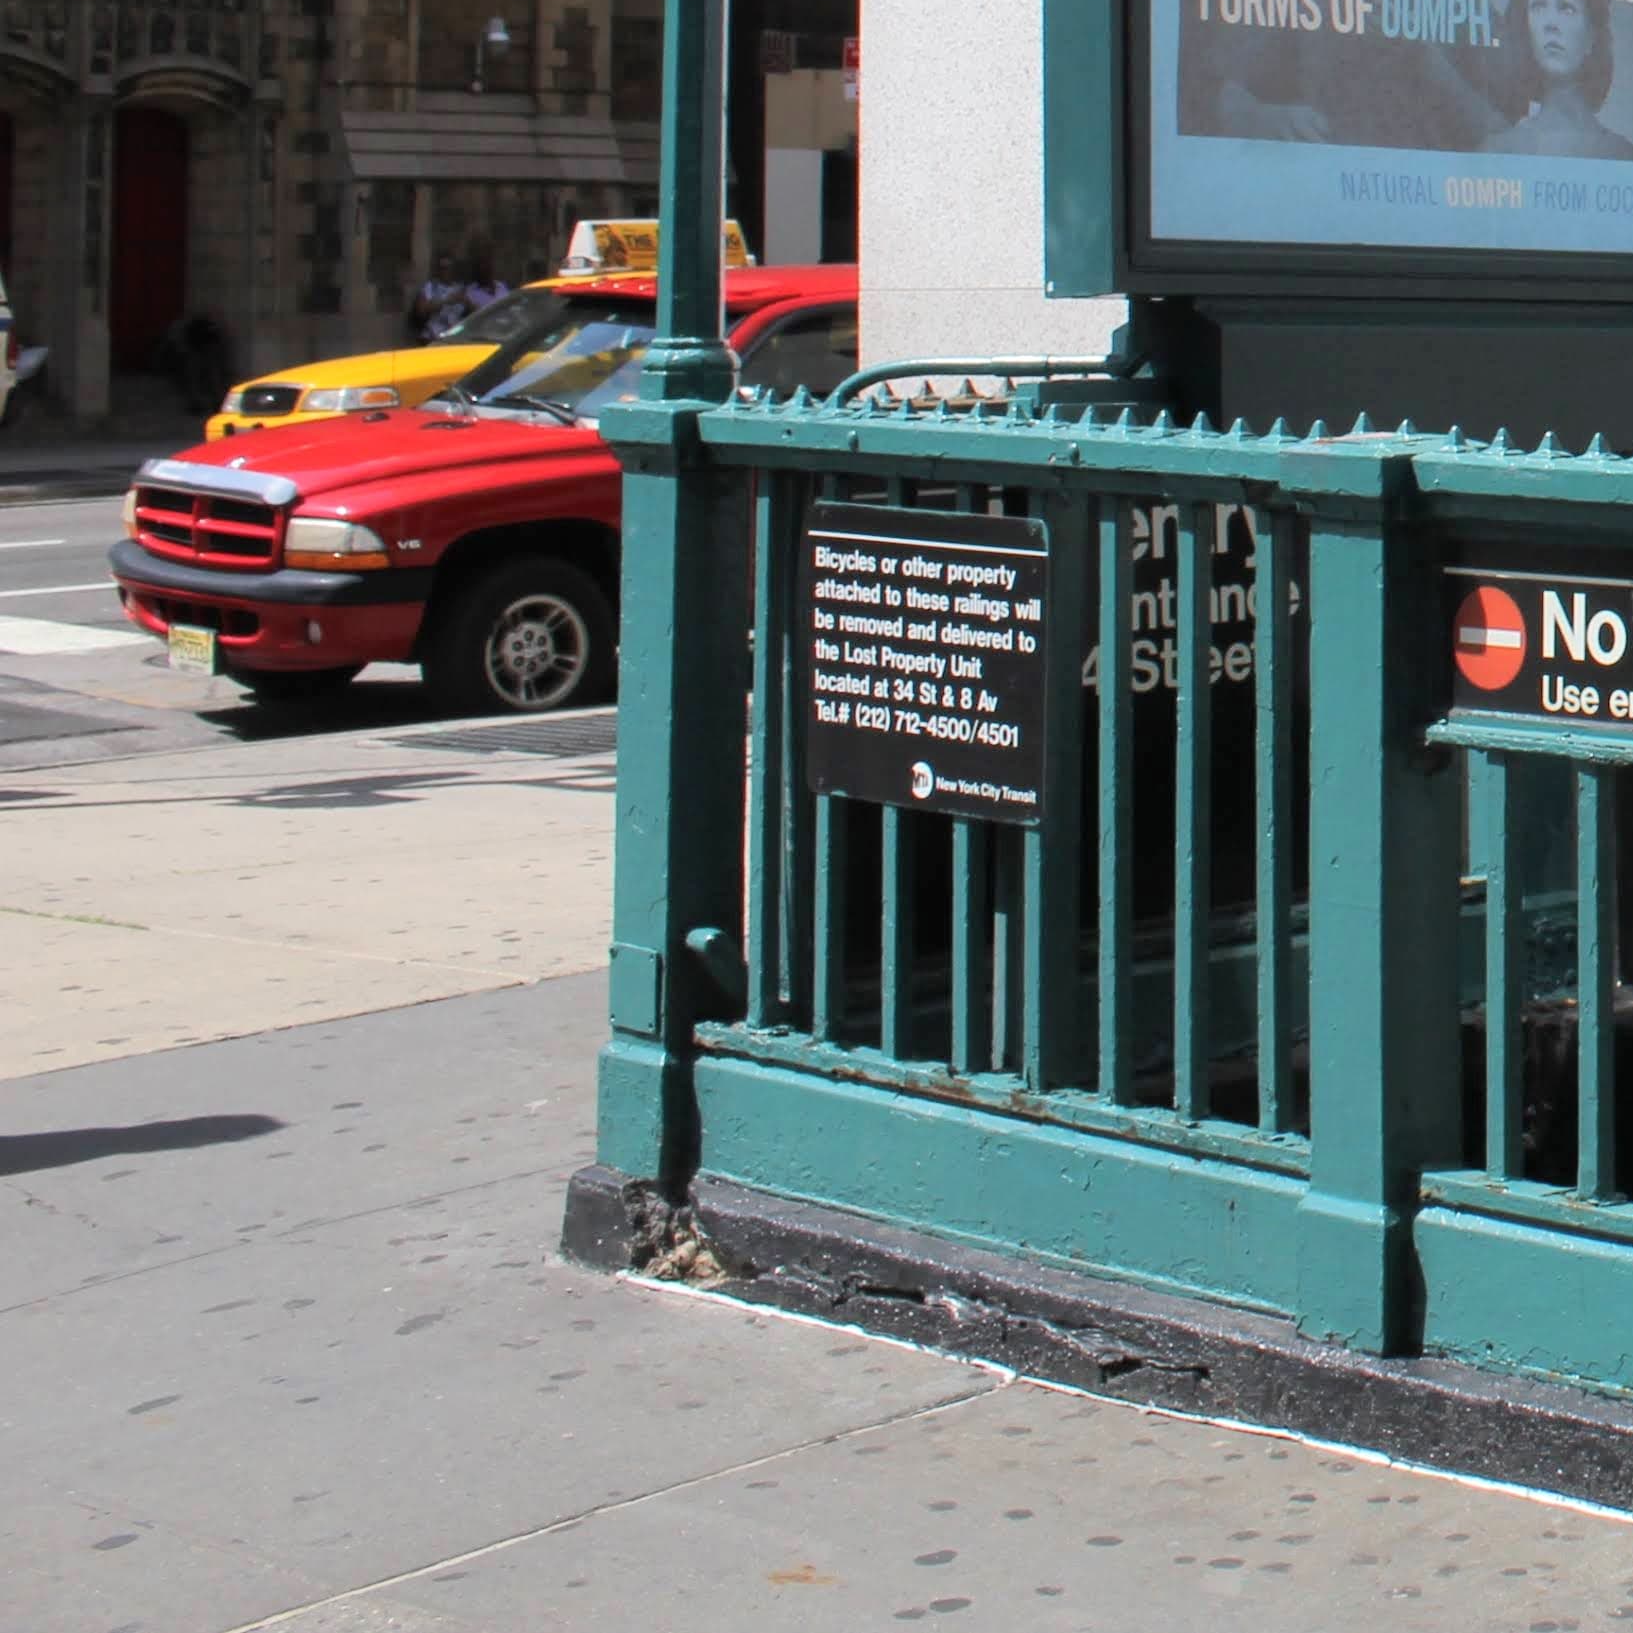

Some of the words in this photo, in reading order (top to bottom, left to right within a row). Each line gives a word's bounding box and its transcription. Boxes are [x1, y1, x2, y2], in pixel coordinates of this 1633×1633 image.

[1340, 171, 1439, 206] NATURAL
[1446, 176, 1523, 208] OOMPH
[1534, 181, 1586, 211] FROM
[815, 546, 876, 573] Bicycles
[881, 558, 897, 575] or
[902, 556, 942, 579] other
[947, 565, 1016, 591] property
[815, 579, 881, 604] attached
[886, 585, 901, 606] to
[906, 587, 949, 612] these
[954, 593, 1009, 621] railings
[1015, 598, 1040, 621] will
[815, 608, 834, 630] be
[839, 615, 902, 638] removed
[908, 621, 936, 642] and
[941, 623, 1012, 650] delivered
[1018, 631, 1036, 653] to
[1542, 590, 1627, 666] No
[815, 639, 839, 661] the
[844, 642, 877, 666] Lost
[881, 646, 946, 678] Property
[951, 654, 982, 679] Unit
[814, 669, 870, 695] located
[874, 679, 889, 699] at
[893, 679, 914, 702] 34
[919, 682, 937, 706] St
[942, 686, 955, 708] &
[960, 687, 972, 710] 8
[977, 689, 998, 713] Av
[1542, 675, 1600, 715] Use
[815, 699, 850, 724] Tel.#
[855, 702, 891, 732] (212)
[894, 711, 1019, 748] 712-4500/4501
[936, 776, 957, 792] New
[958, 779, 980, 795] York
[980, 783, 1001, 802] City
[1001, 785, 1037, 804] Transit
